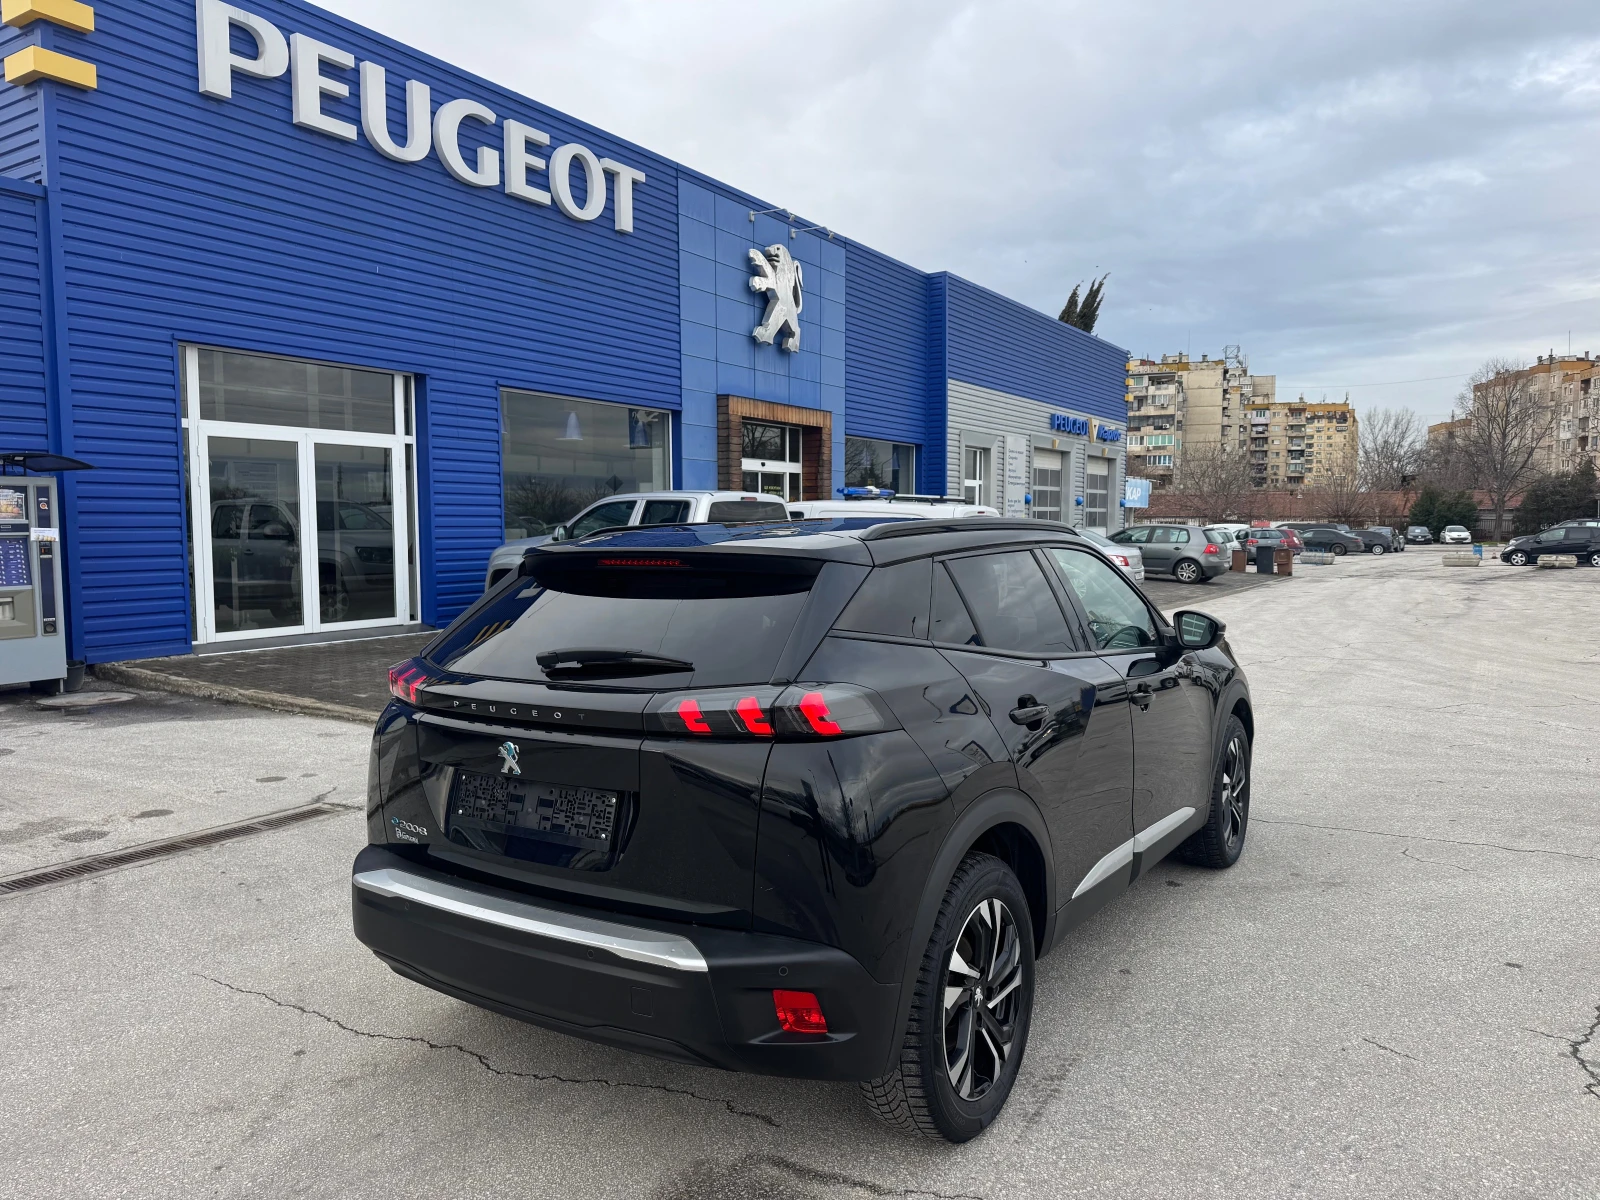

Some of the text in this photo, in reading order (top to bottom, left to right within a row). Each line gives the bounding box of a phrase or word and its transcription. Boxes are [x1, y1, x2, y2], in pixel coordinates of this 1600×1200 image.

[196, 0, 647, 234] PEUGEOT
[1051, 413, 1090, 436] PEUGEOT
[453, 700, 585, 721] PEUGEOT
